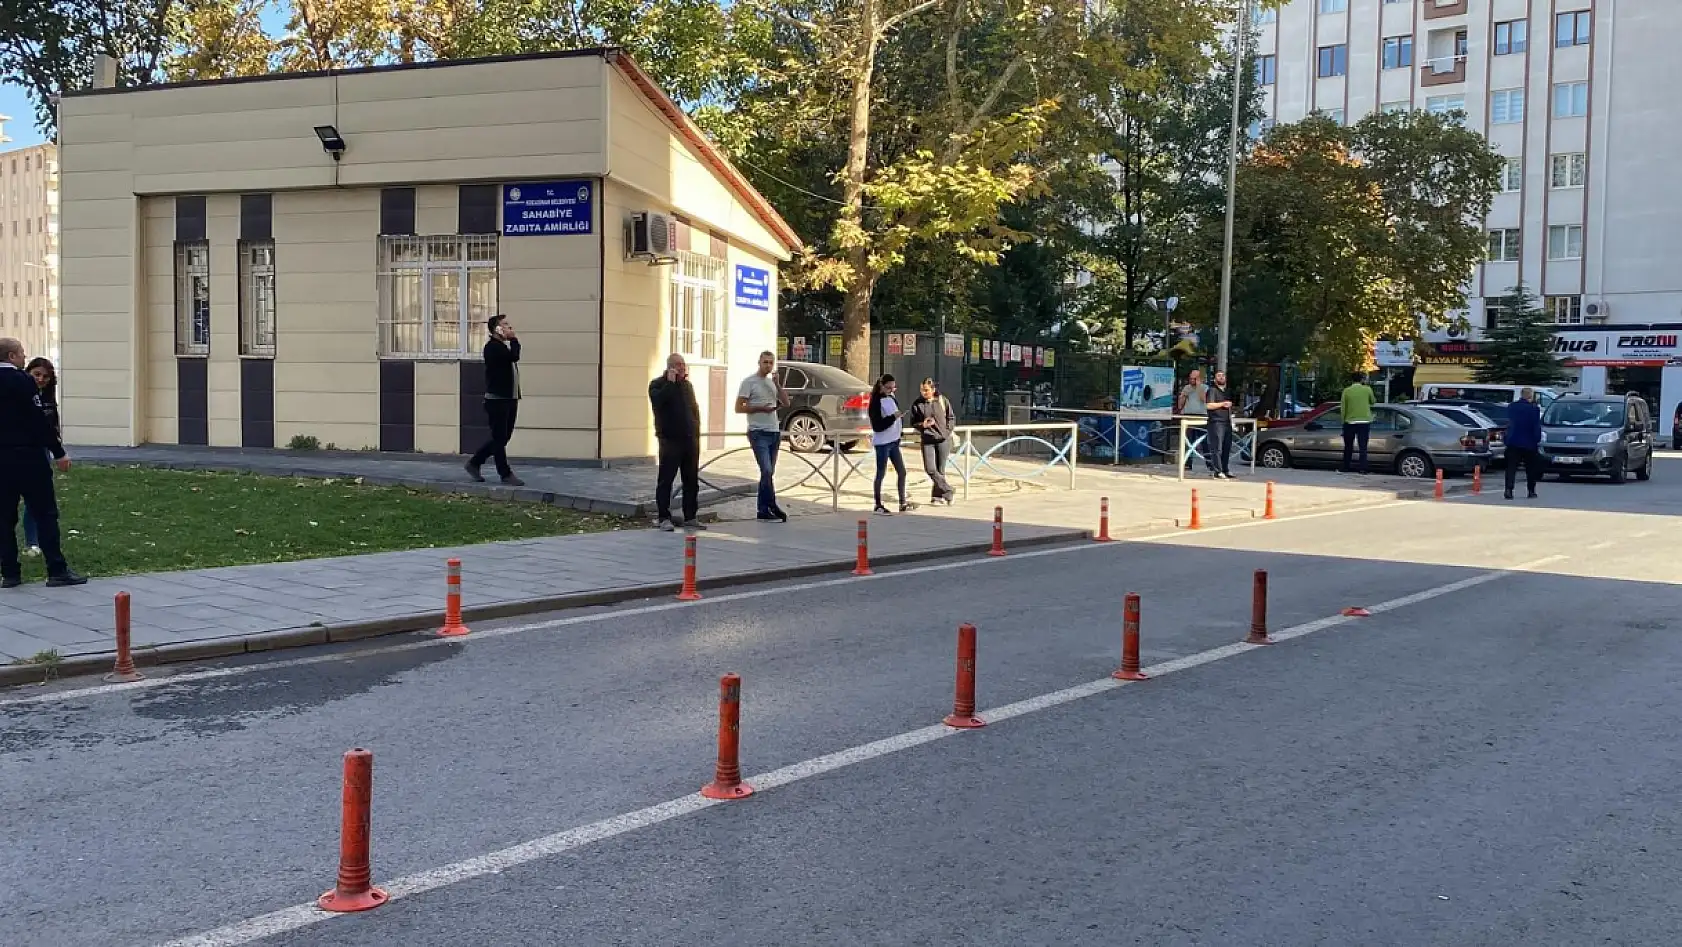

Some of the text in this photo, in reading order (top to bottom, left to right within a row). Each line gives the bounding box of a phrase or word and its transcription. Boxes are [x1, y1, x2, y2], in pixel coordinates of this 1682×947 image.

[522, 208, 572, 218] SAHABİYE
[505, 220, 589, 233] ZABITA AMİRLİĞİ
